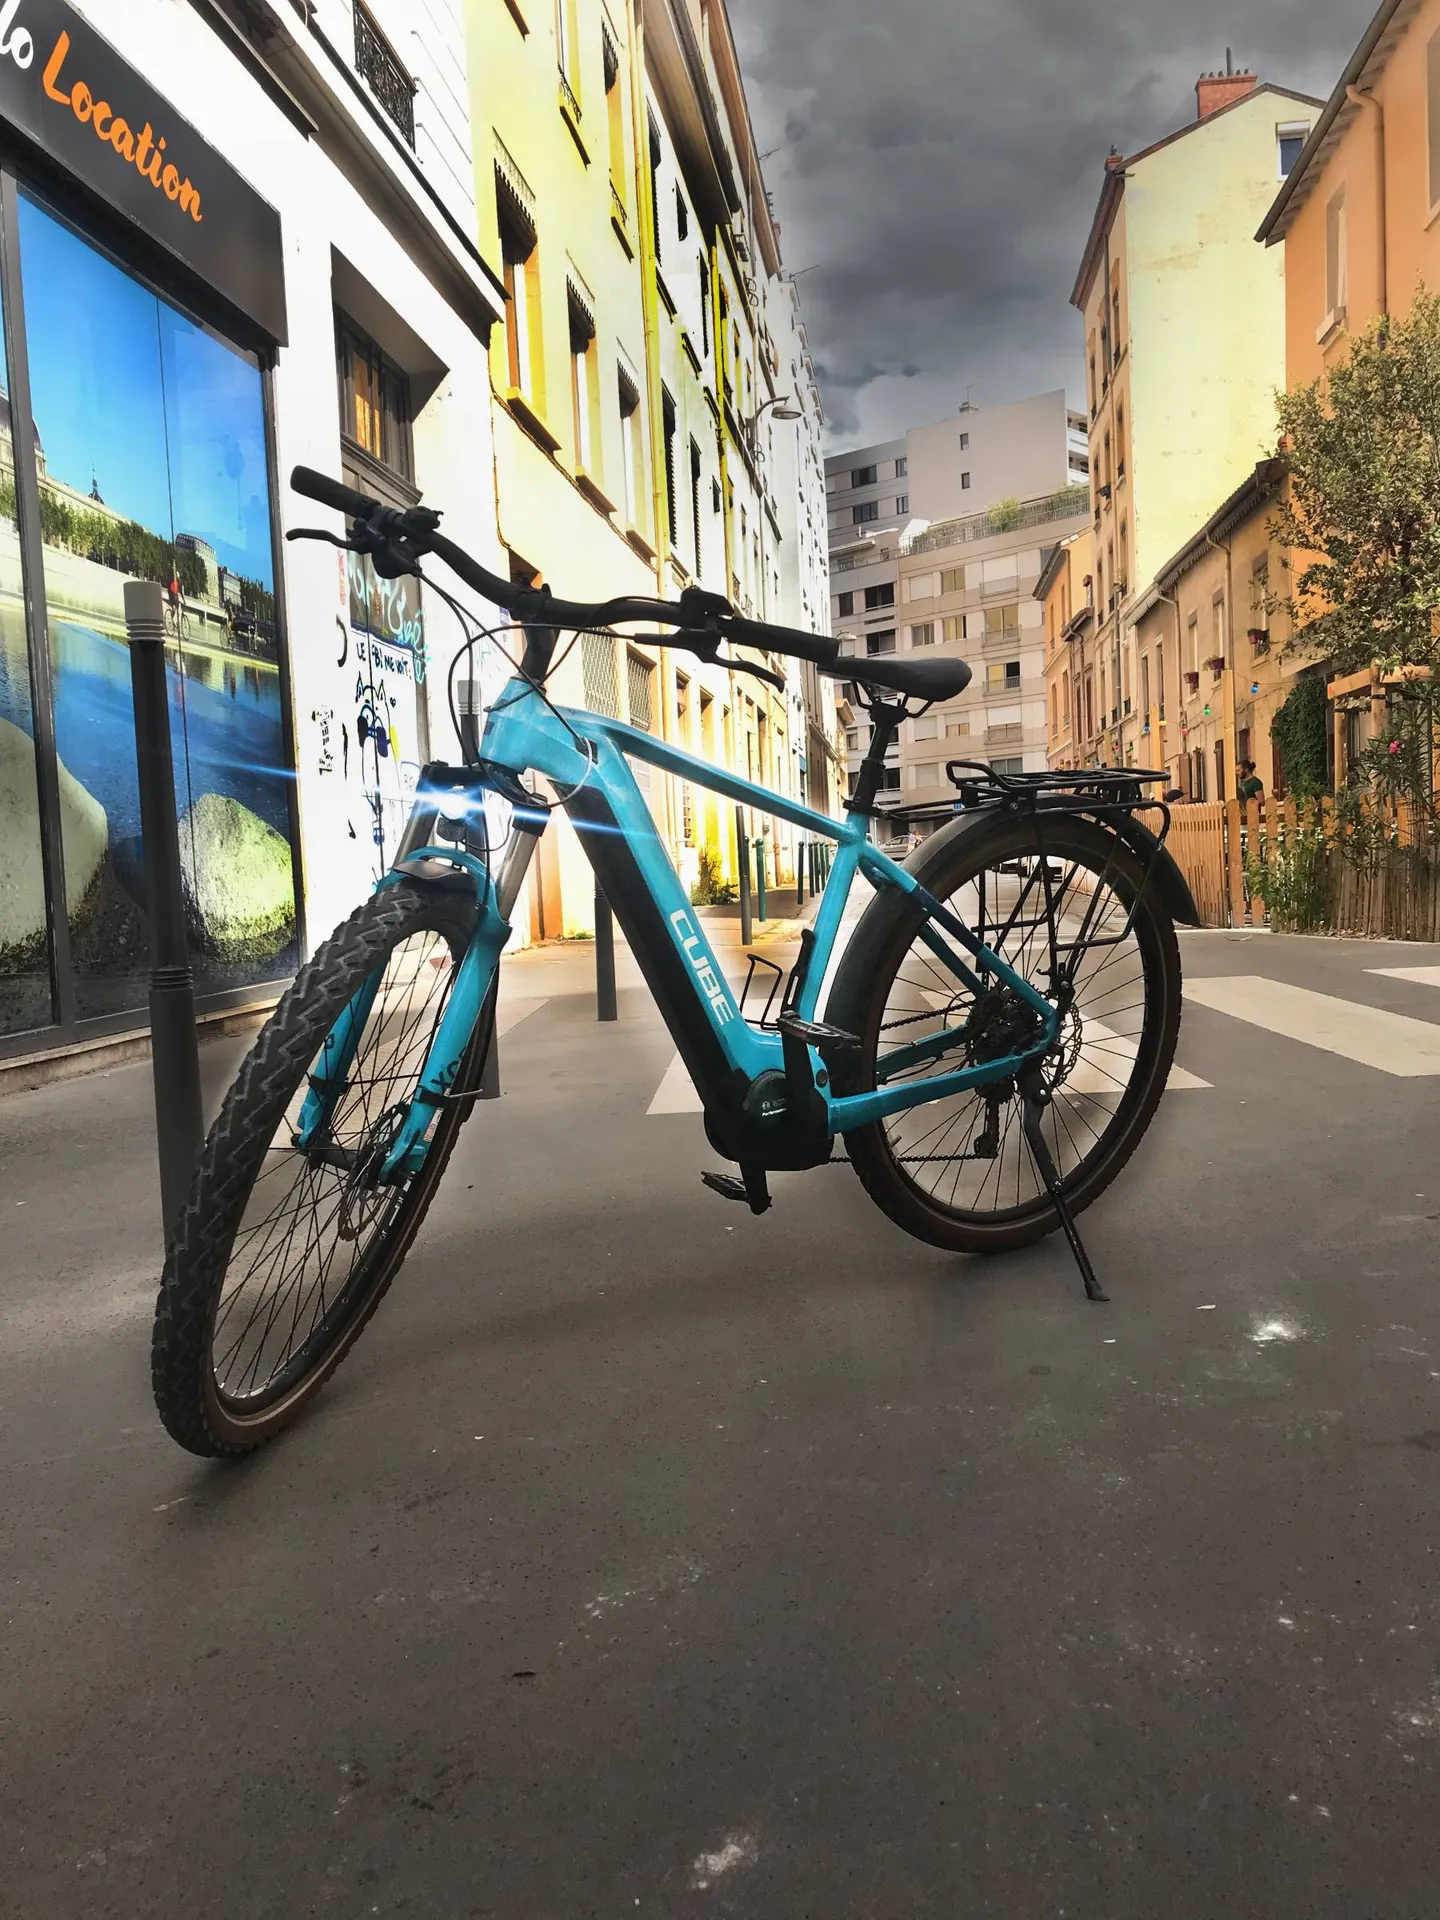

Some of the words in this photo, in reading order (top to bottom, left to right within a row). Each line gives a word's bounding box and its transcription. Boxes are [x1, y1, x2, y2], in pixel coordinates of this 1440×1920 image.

[42, 30, 203, 222] Location
[356, 642, 366, 661] LE
[670, 908, 734, 1025] CUBE
